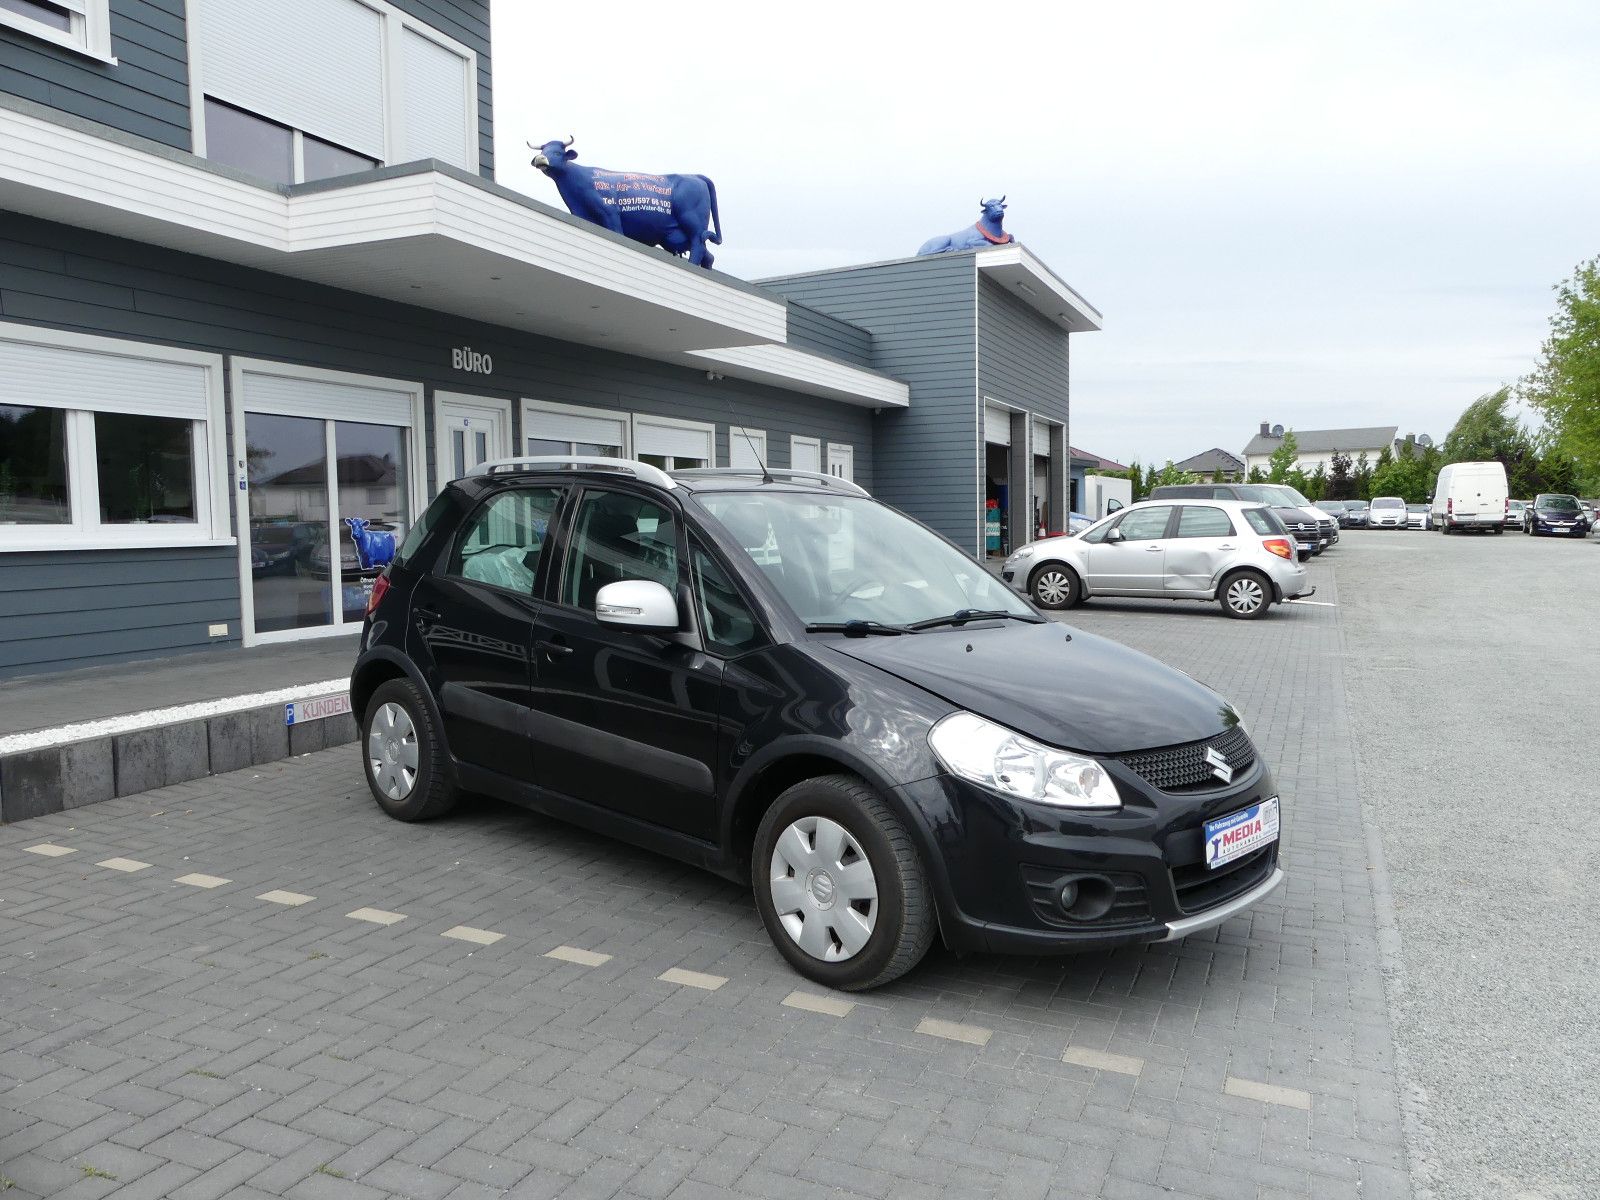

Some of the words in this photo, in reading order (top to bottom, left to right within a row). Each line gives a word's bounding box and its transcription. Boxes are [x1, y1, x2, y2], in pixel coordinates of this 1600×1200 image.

[602, 197, 617, 205] Tel.
[618, 197, 649, 206] 0391/597
[452, 346, 492, 375] BÜRO
[287, 708, 294, 721] P
[303, 695, 349, 719] KUNDEN
[1214, 819, 1231, 830] Fahrzeug
[1222, 819, 1262, 847] MEDIA
[1223, 833, 1263, 854] AUTOHANDEL
